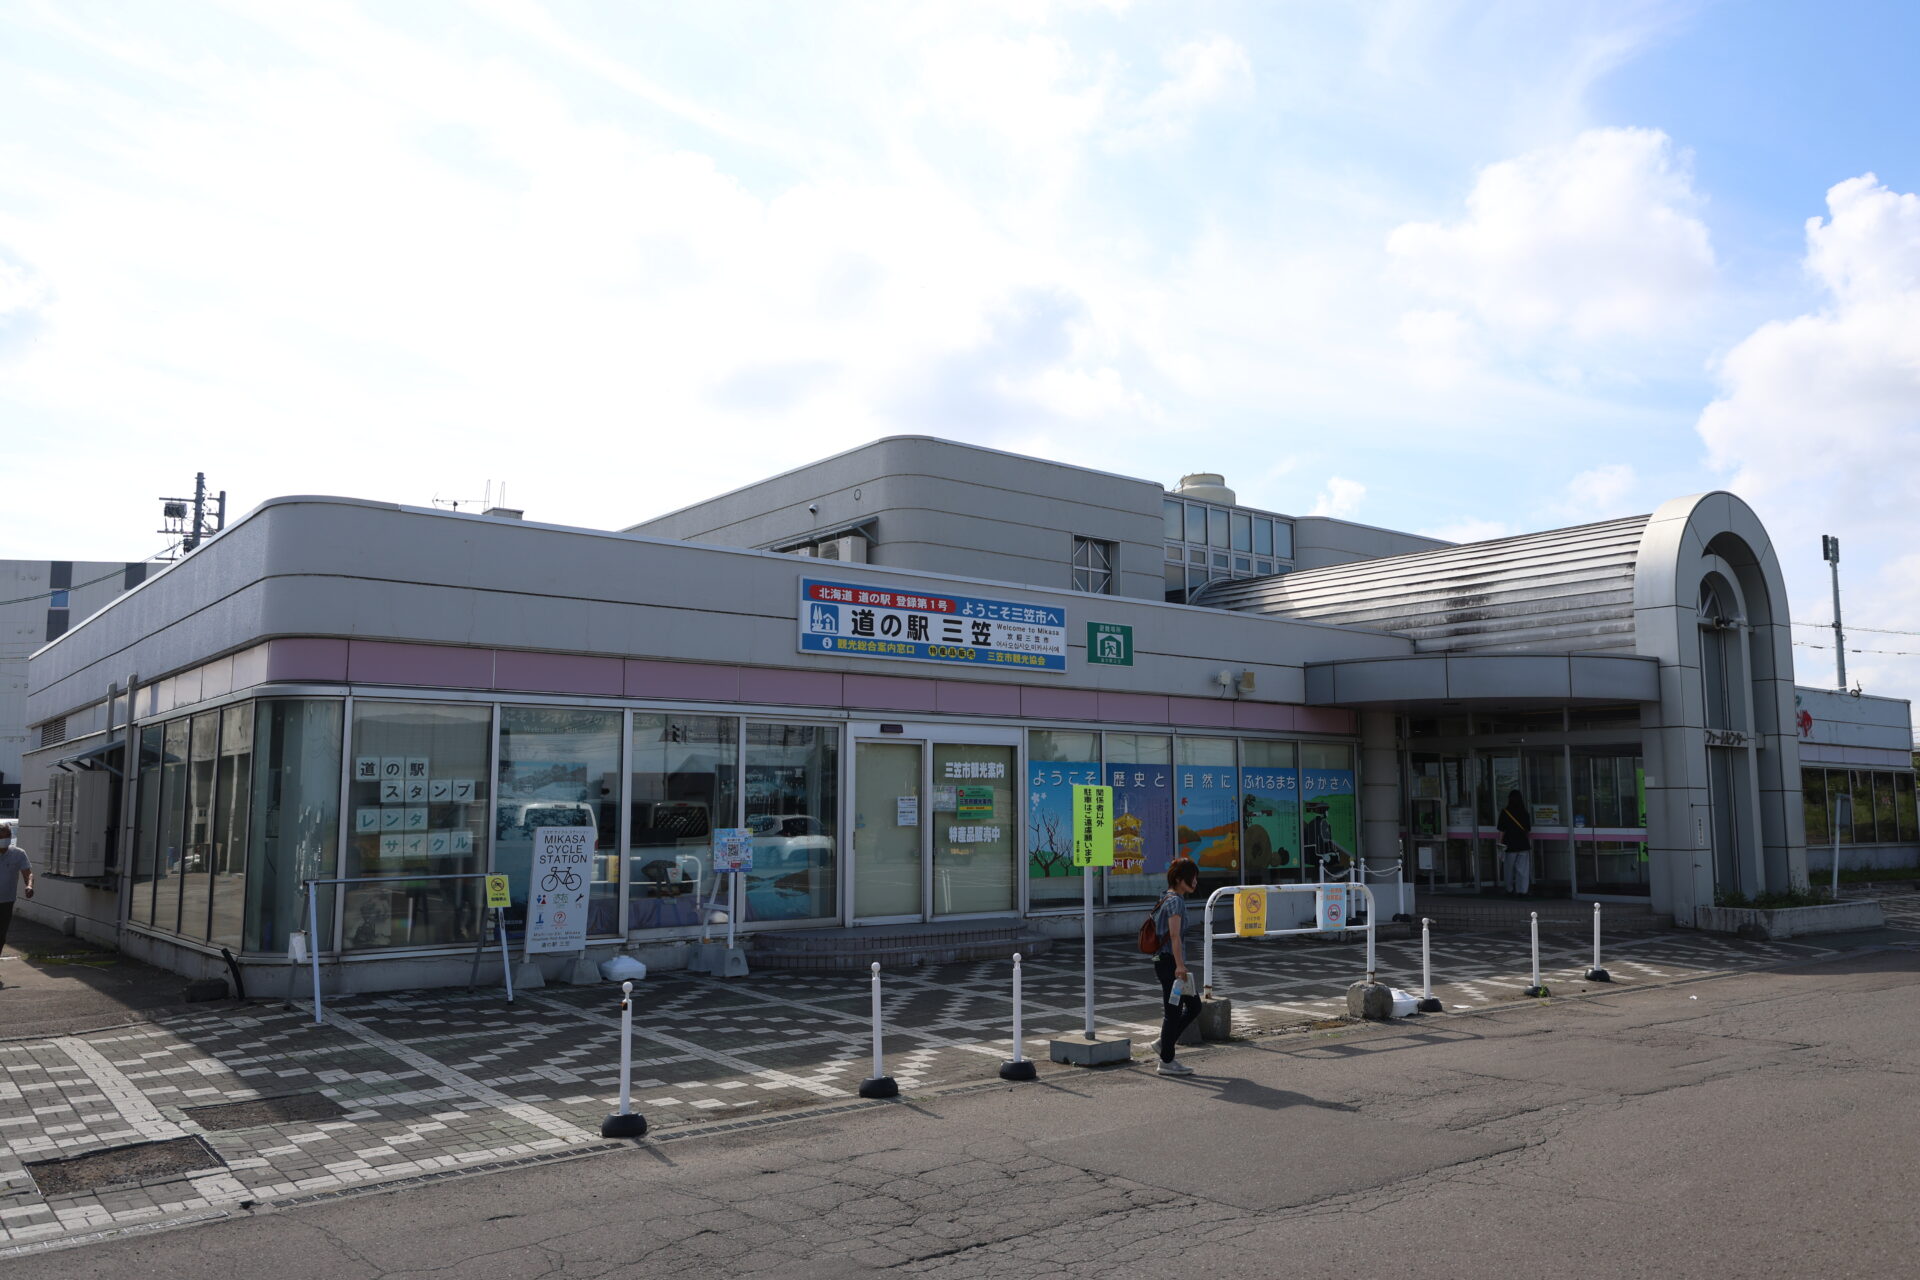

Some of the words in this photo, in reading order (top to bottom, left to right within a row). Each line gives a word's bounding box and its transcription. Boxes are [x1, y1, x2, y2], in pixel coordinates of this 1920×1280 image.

[819, 587, 852, 602] 北海道
[858, 592, 891, 606] 道の駅
[962, 601, 1059, 624] ようこそ三笠市へ
[852, 609, 930, 642] 道の駅
[942, 618, 992, 646] 三笠
[996, 624, 1026, 633] Welcome
[1038, 627, 1060, 636] Mikasa
[837, 638, 915, 654] 観光総合案内窓口
[986, 652, 1046, 666] 三笠市観光協会
[360, 762, 424, 776] 道の駅
[944, 762, 1004, 779] 三笠市観光案内
[1032, 770, 1096, 786] ようこそ
[1113, 771, 1166, 788] 歴史と
[1184, 774, 1232, 789] 自然に
[1244, 775, 1296, 790] ふれるまち
[1305, 776, 1352, 790] みかさへ
[386, 784, 470, 798] スタンプ
[1096, 788, 1104, 828] 関係者以外
[362, 814, 422, 827] レンタ
[1084, 788, 1092, 864] 駐車はご遠慮願います
[544, 835, 586, 844] MIKASA
[948, 826, 1001, 844] 特産品販売中
[385, 836, 468, 852] サイクル
[546, 844, 583, 854] CYCLE
[540, 854, 588, 864] STATION
